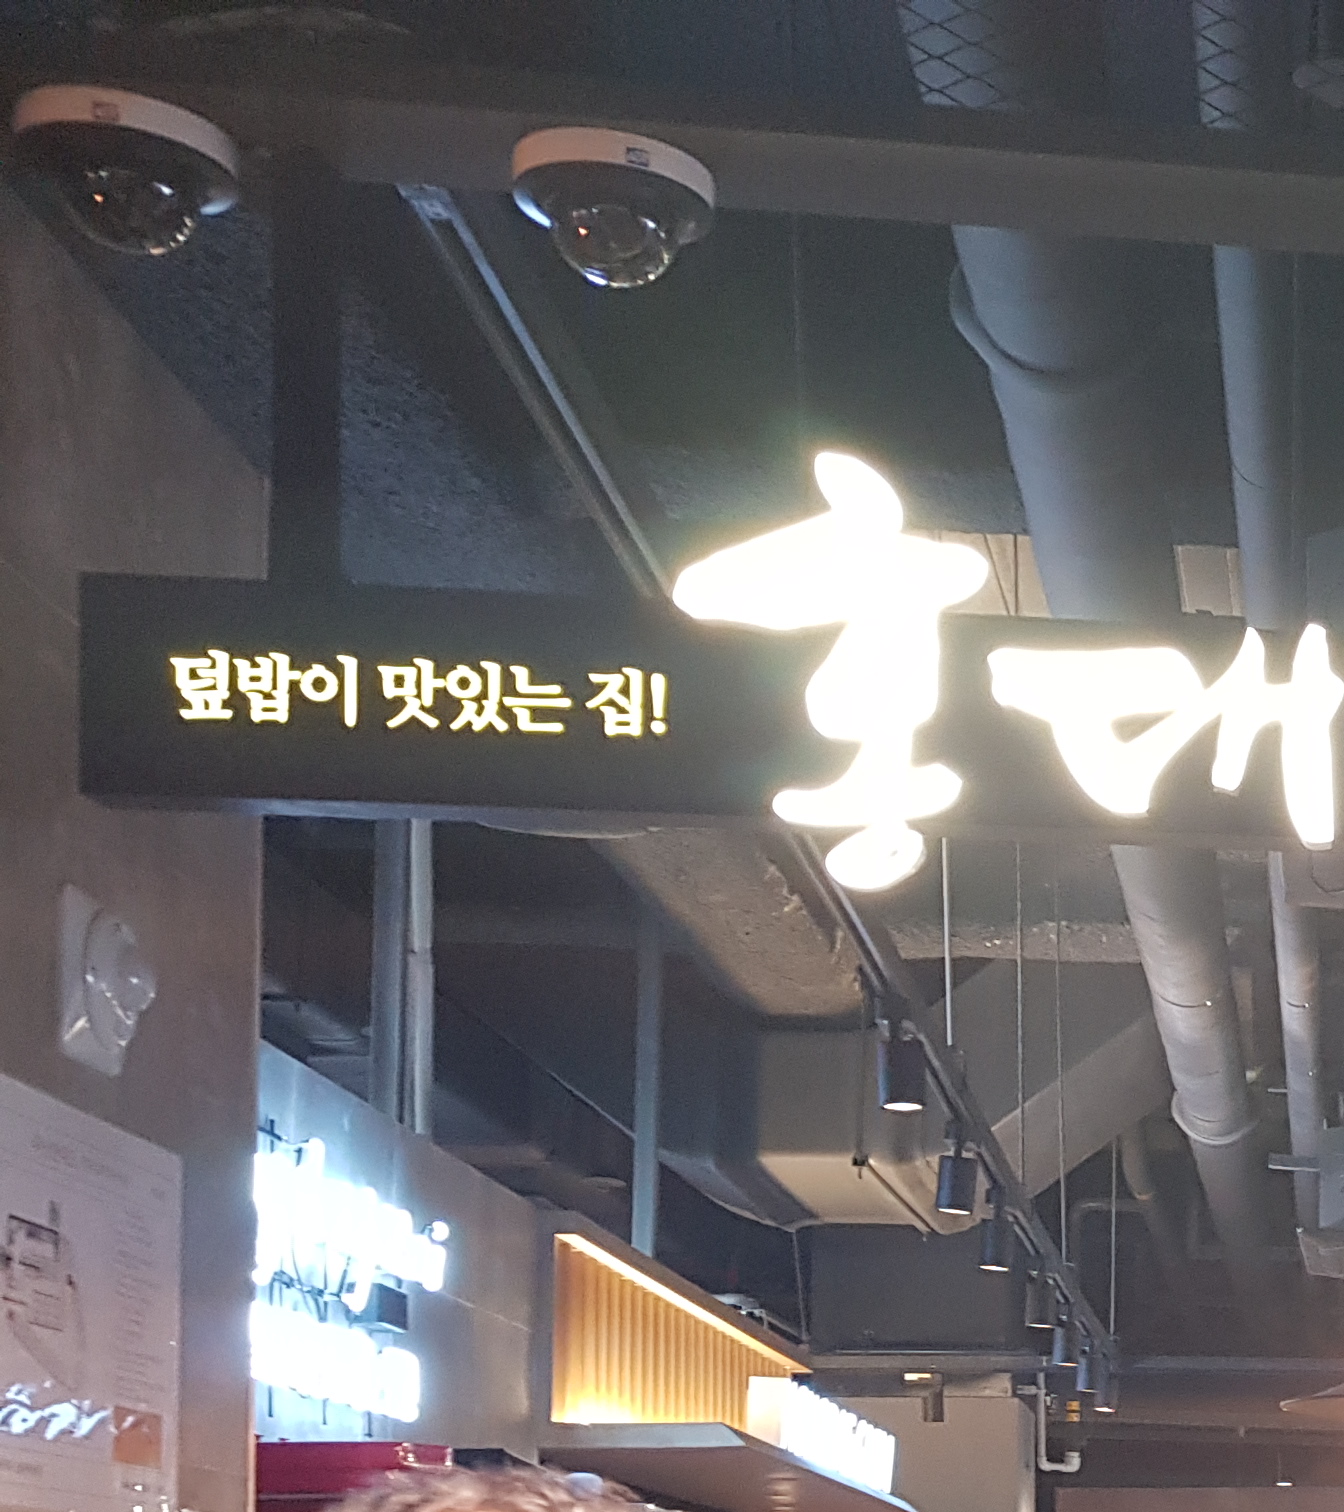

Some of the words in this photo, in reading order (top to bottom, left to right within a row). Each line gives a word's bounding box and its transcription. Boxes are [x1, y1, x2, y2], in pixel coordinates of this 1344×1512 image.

[169, 648, 359, 729] 덮밥이
[376, 656, 573, 734] 맛있는
[585, 665, 670, 738] 집!
